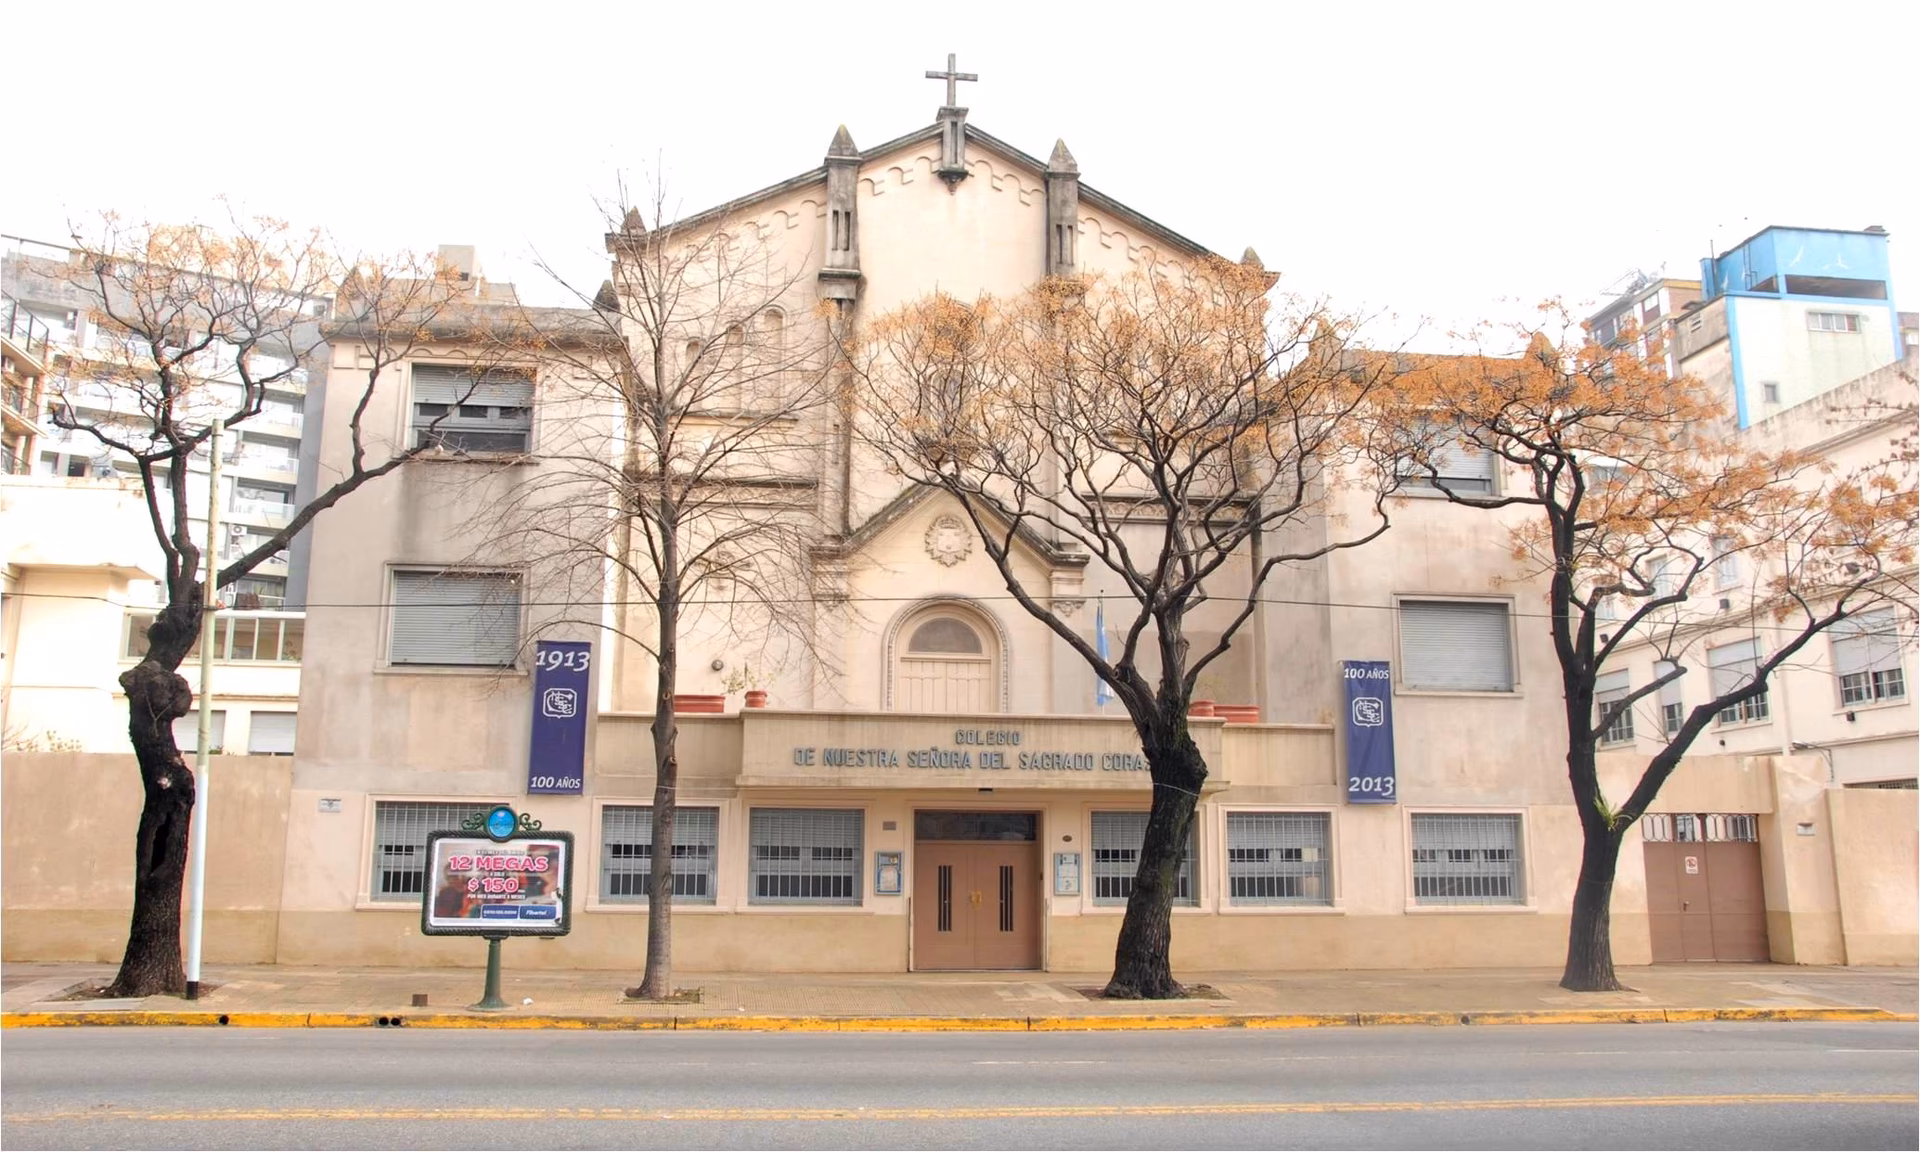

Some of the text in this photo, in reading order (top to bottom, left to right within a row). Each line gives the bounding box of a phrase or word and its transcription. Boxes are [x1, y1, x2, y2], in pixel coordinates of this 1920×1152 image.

[535, 650, 591, 672] 1913
[1344, 668, 1389, 679] 100 AÑOS
[956, 729, 1021, 746] COLEGIO
[794, 746, 1151, 772] DE NUESTRA SEÑORA DEL SAGRADO CORA
[531, 776, 581, 789] 100 AÑOS
[1348, 776, 1395, 797] 2013
[449, 855, 549, 872] 12 MEGAS
[482, 877, 519, 893] 150
